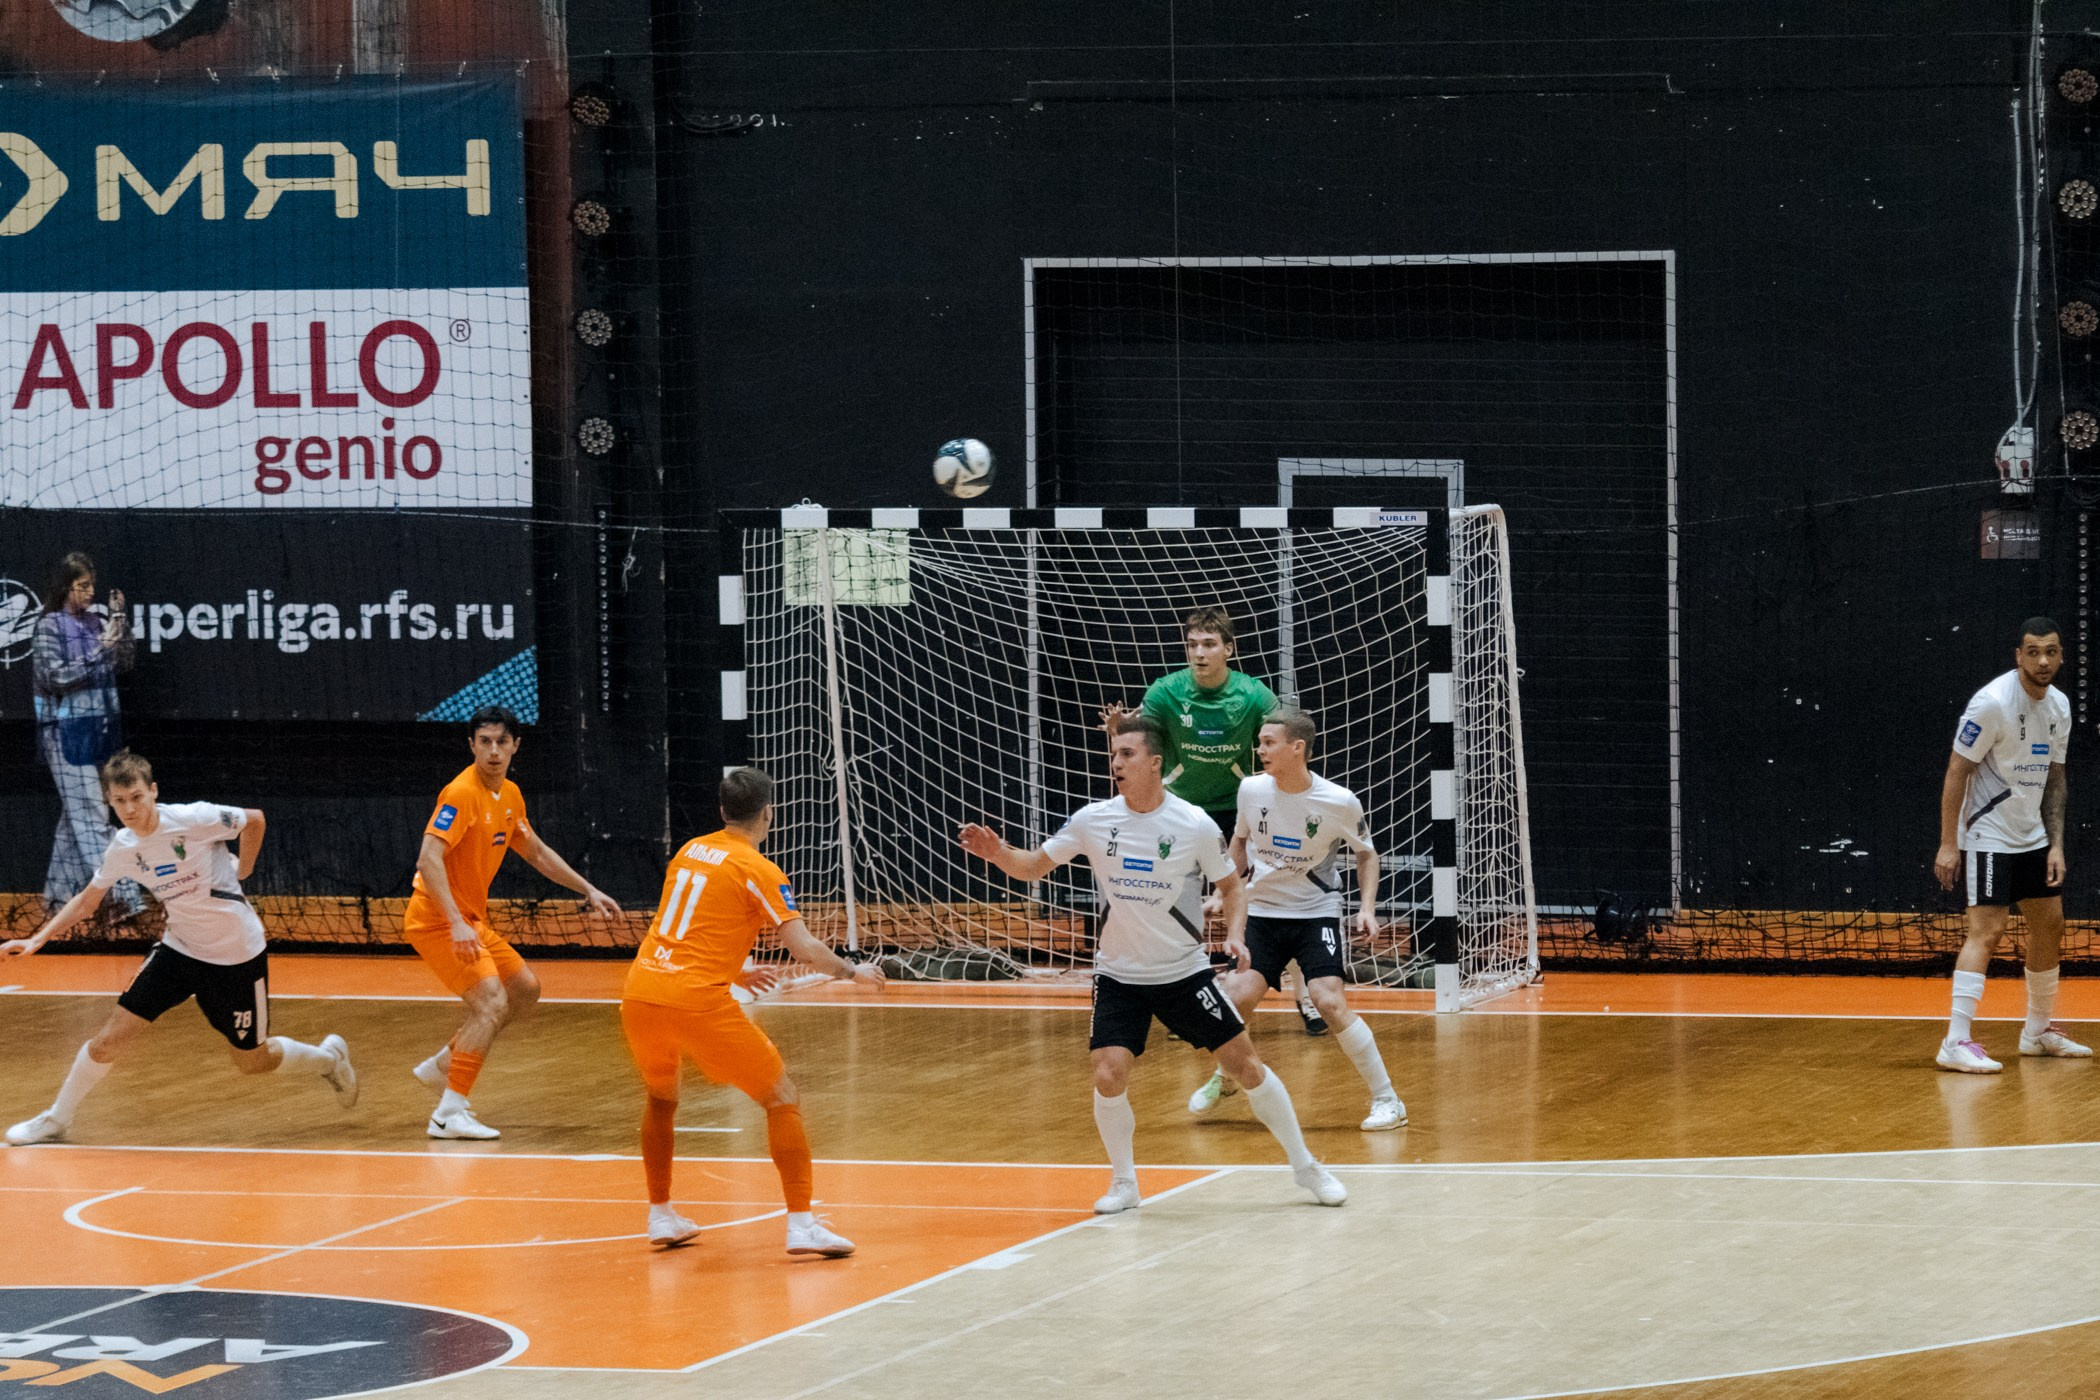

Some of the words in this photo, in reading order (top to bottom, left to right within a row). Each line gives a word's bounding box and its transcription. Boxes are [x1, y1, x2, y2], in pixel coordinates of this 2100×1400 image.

[96, 138, 491, 221] МЯЧ
[254, 417, 443, 496] genio
[1180, 714, 1193, 728] 30
[2020, 727, 2026, 741] 9
[1181, 742, 1241, 754] ИНГОССТРАХ
[1258, 821, 1268, 835] 41
[1107, 842, 1118, 857] 21
[659, 868, 708, 941] 11
[1322, 927, 1336, 945] 41
[1196, 986, 1218, 1011] 21
[233, 1010, 252, 1028] 78
